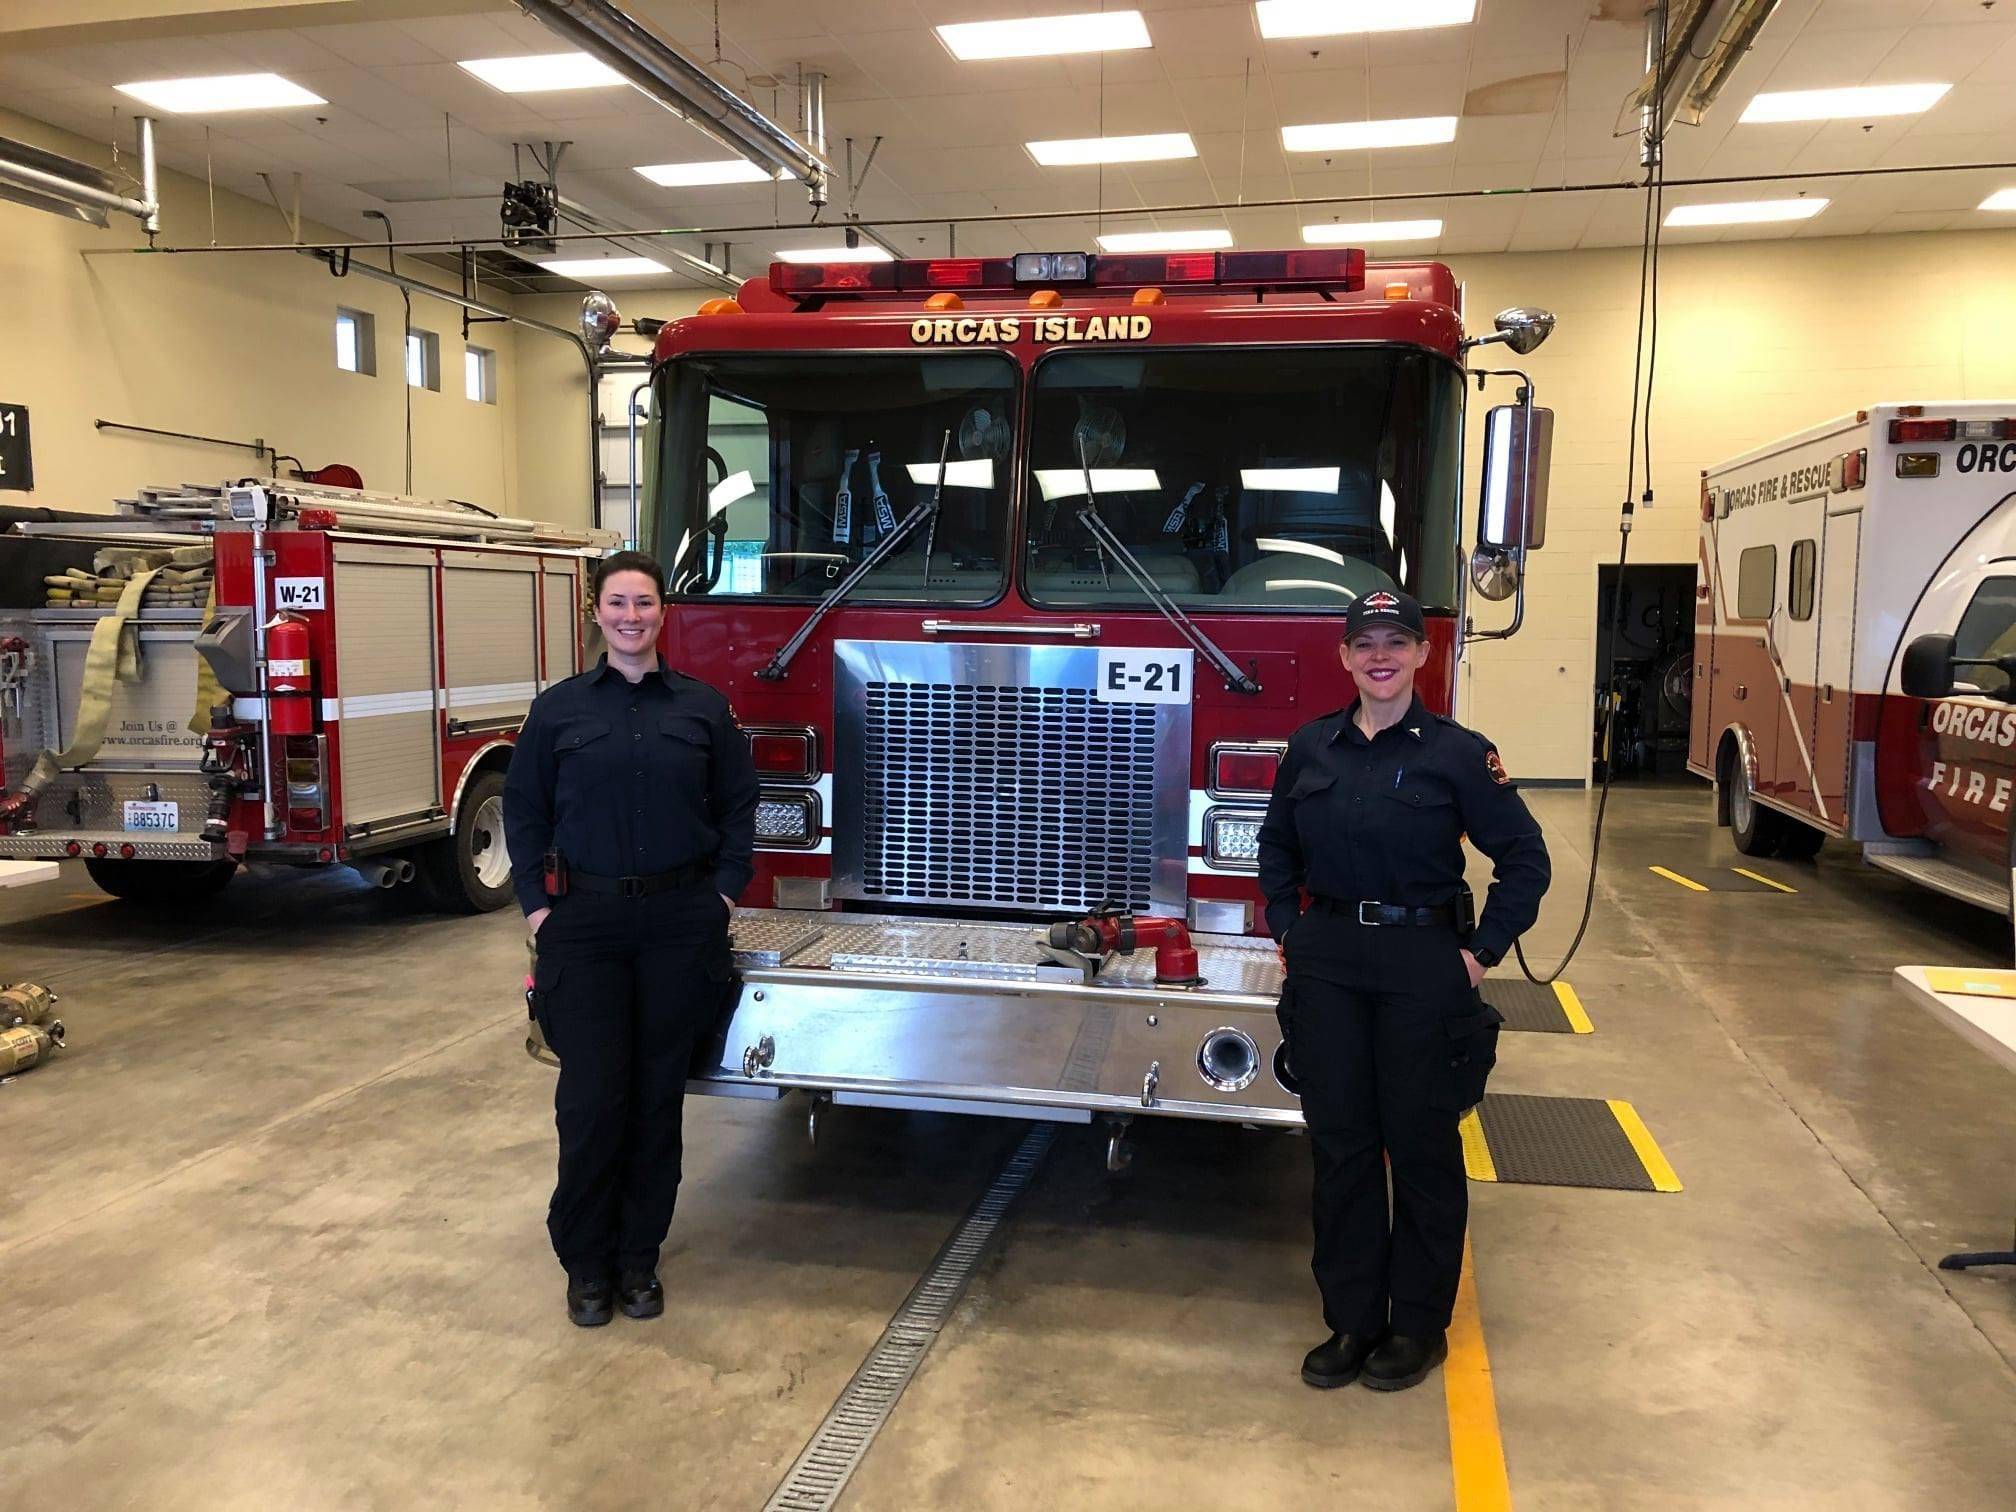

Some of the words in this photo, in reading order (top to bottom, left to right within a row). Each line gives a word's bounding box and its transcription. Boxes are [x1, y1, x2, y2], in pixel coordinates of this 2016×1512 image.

[910, 318, 1021, 344] ORCAS
[1033, 315, 1153, 342] ISLAND
[1728, 484, 1757, 513] ORCAS
[1757, 477, 1779, 504] FIRE
[1780, 474, 1788, 499] &
[1789, 461, 1832, 495] RESCUE
[837, 494, 849, 528] MSA
[875, 496, 894, 531] MSA
[280, 586, 320, 603] W-21
[1108, 662, 1181, 692] E-21
[120, 720, 145, 733] Join
[148, 720, 163, 733] Us
[166, 720, 178, 733] @
[1932, 702, 2016, 747] ORCAS
[1927, 761, 2012, 812] FIRE
